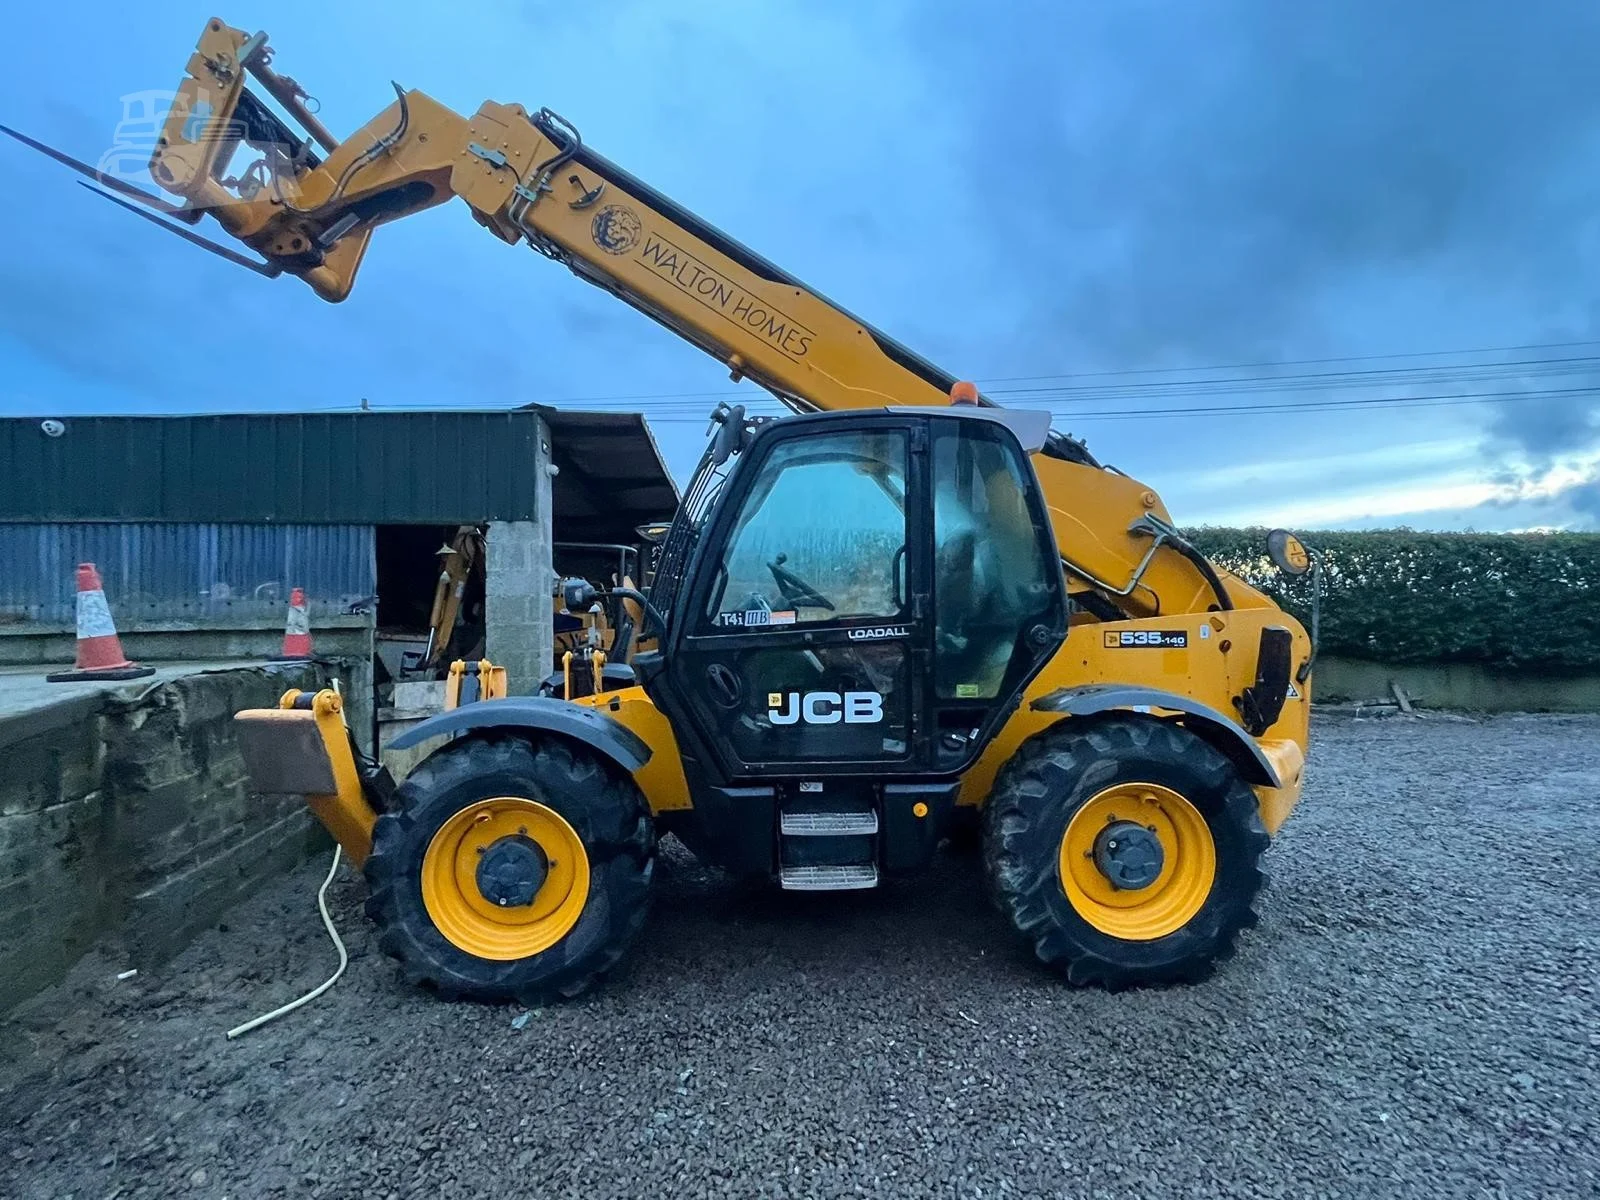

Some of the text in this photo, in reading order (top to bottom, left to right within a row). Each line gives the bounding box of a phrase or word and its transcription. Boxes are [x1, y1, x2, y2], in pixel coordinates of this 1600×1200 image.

[642, 237, 813, 357] WALTON HOMES
[721, 612, 744, 626] T4i
[847, 627, 910, 639] LOADALL
[1120, 631, 1185, 644] 535-140
[768, 691, 884, 724] JCB
